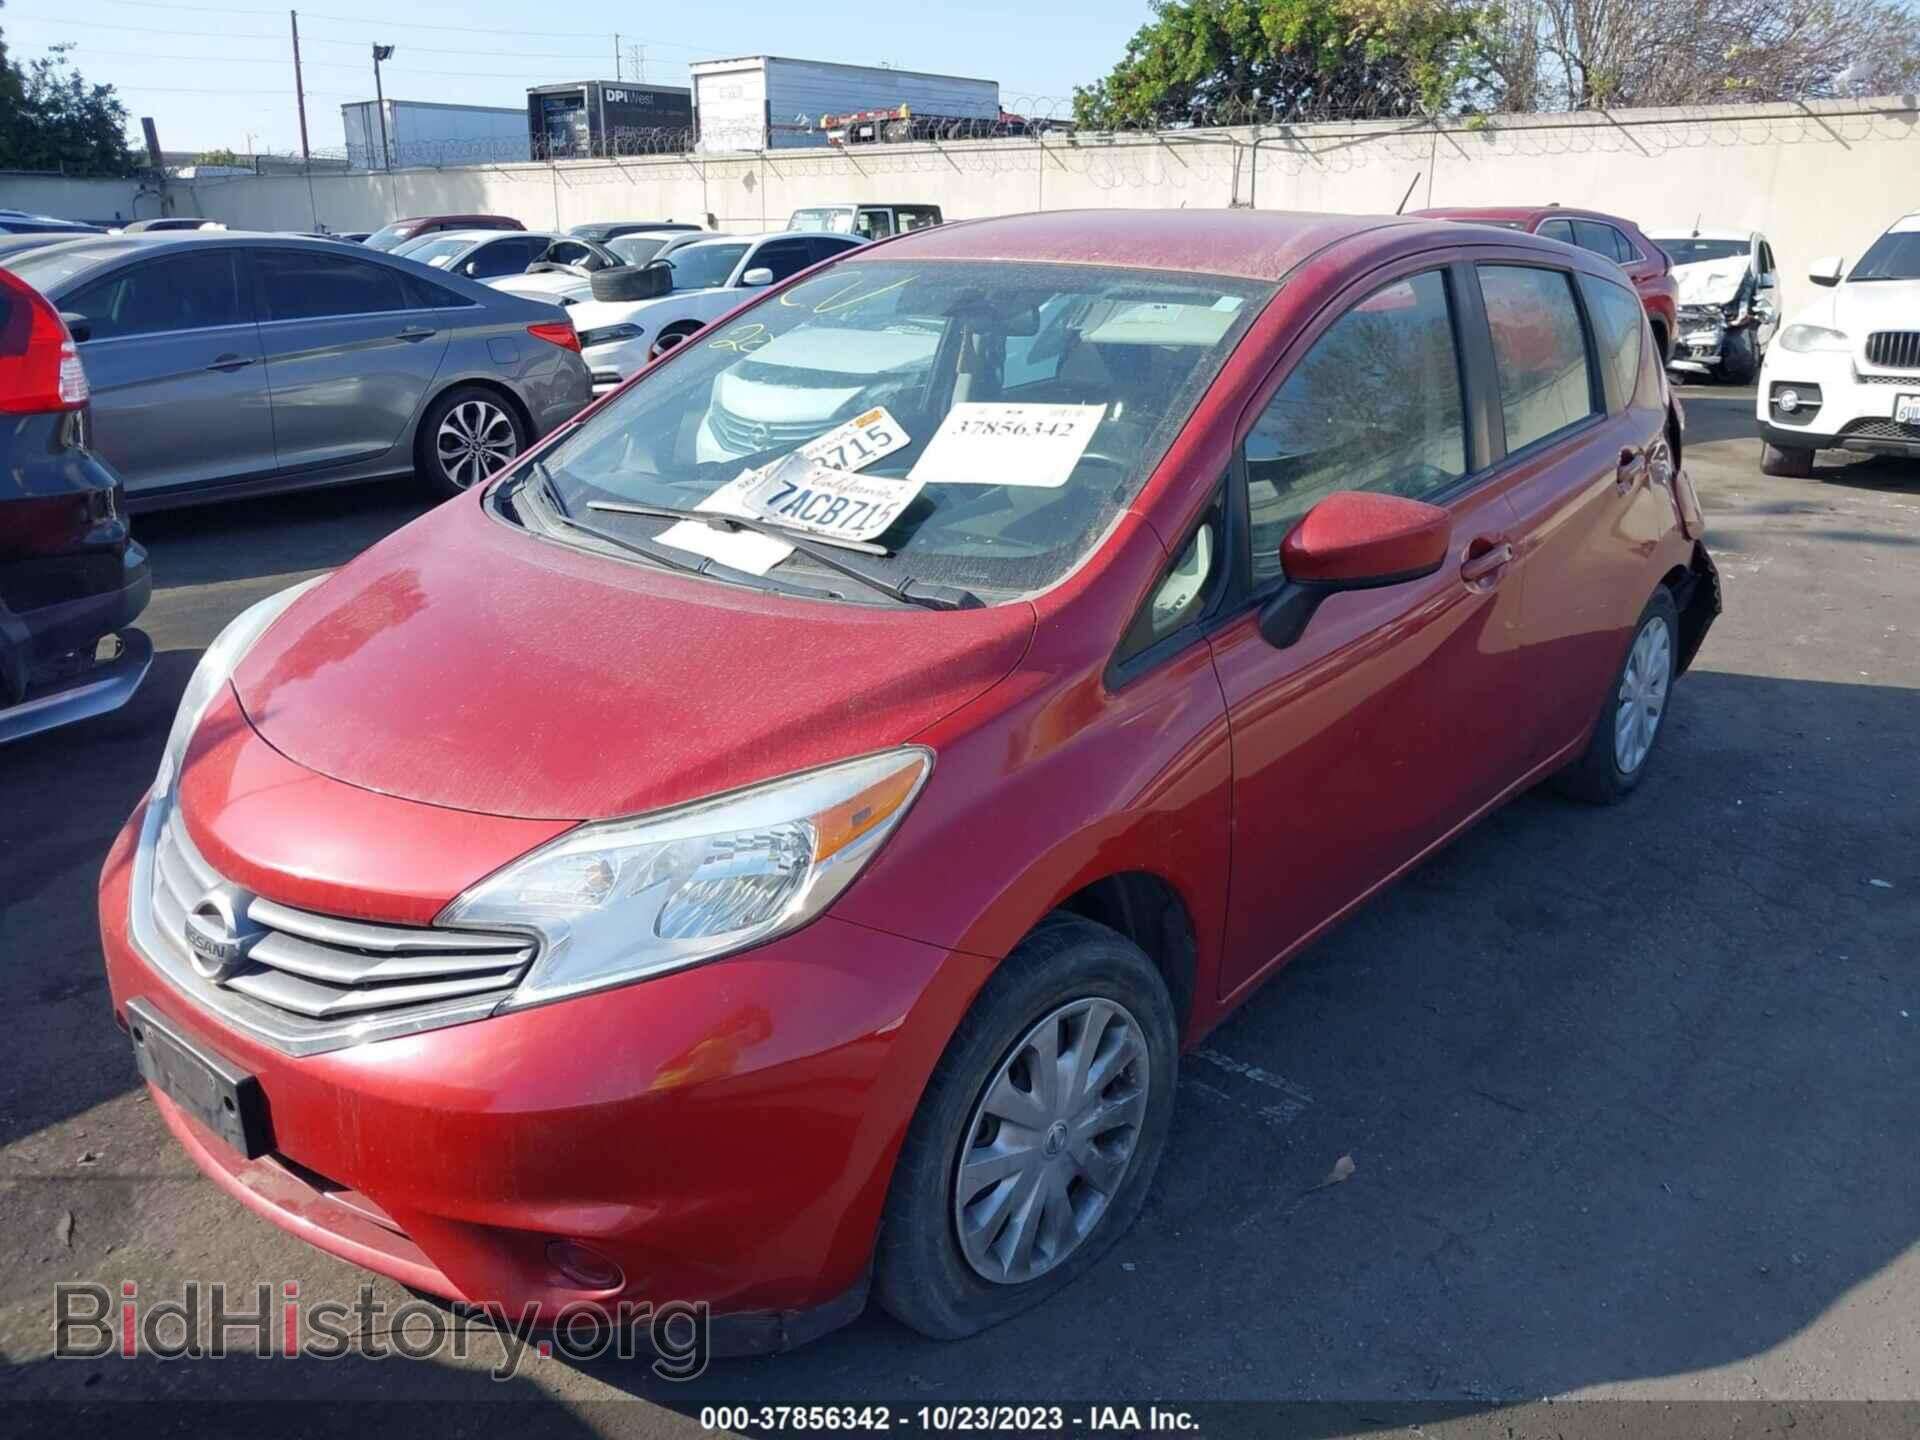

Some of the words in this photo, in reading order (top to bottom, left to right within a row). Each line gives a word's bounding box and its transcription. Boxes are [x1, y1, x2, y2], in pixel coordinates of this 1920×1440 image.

[605, 89, 628, 103] DPI
[952, 420, 1075, 437] 37856342
[767, 480, 900, 530] 7ACB715
